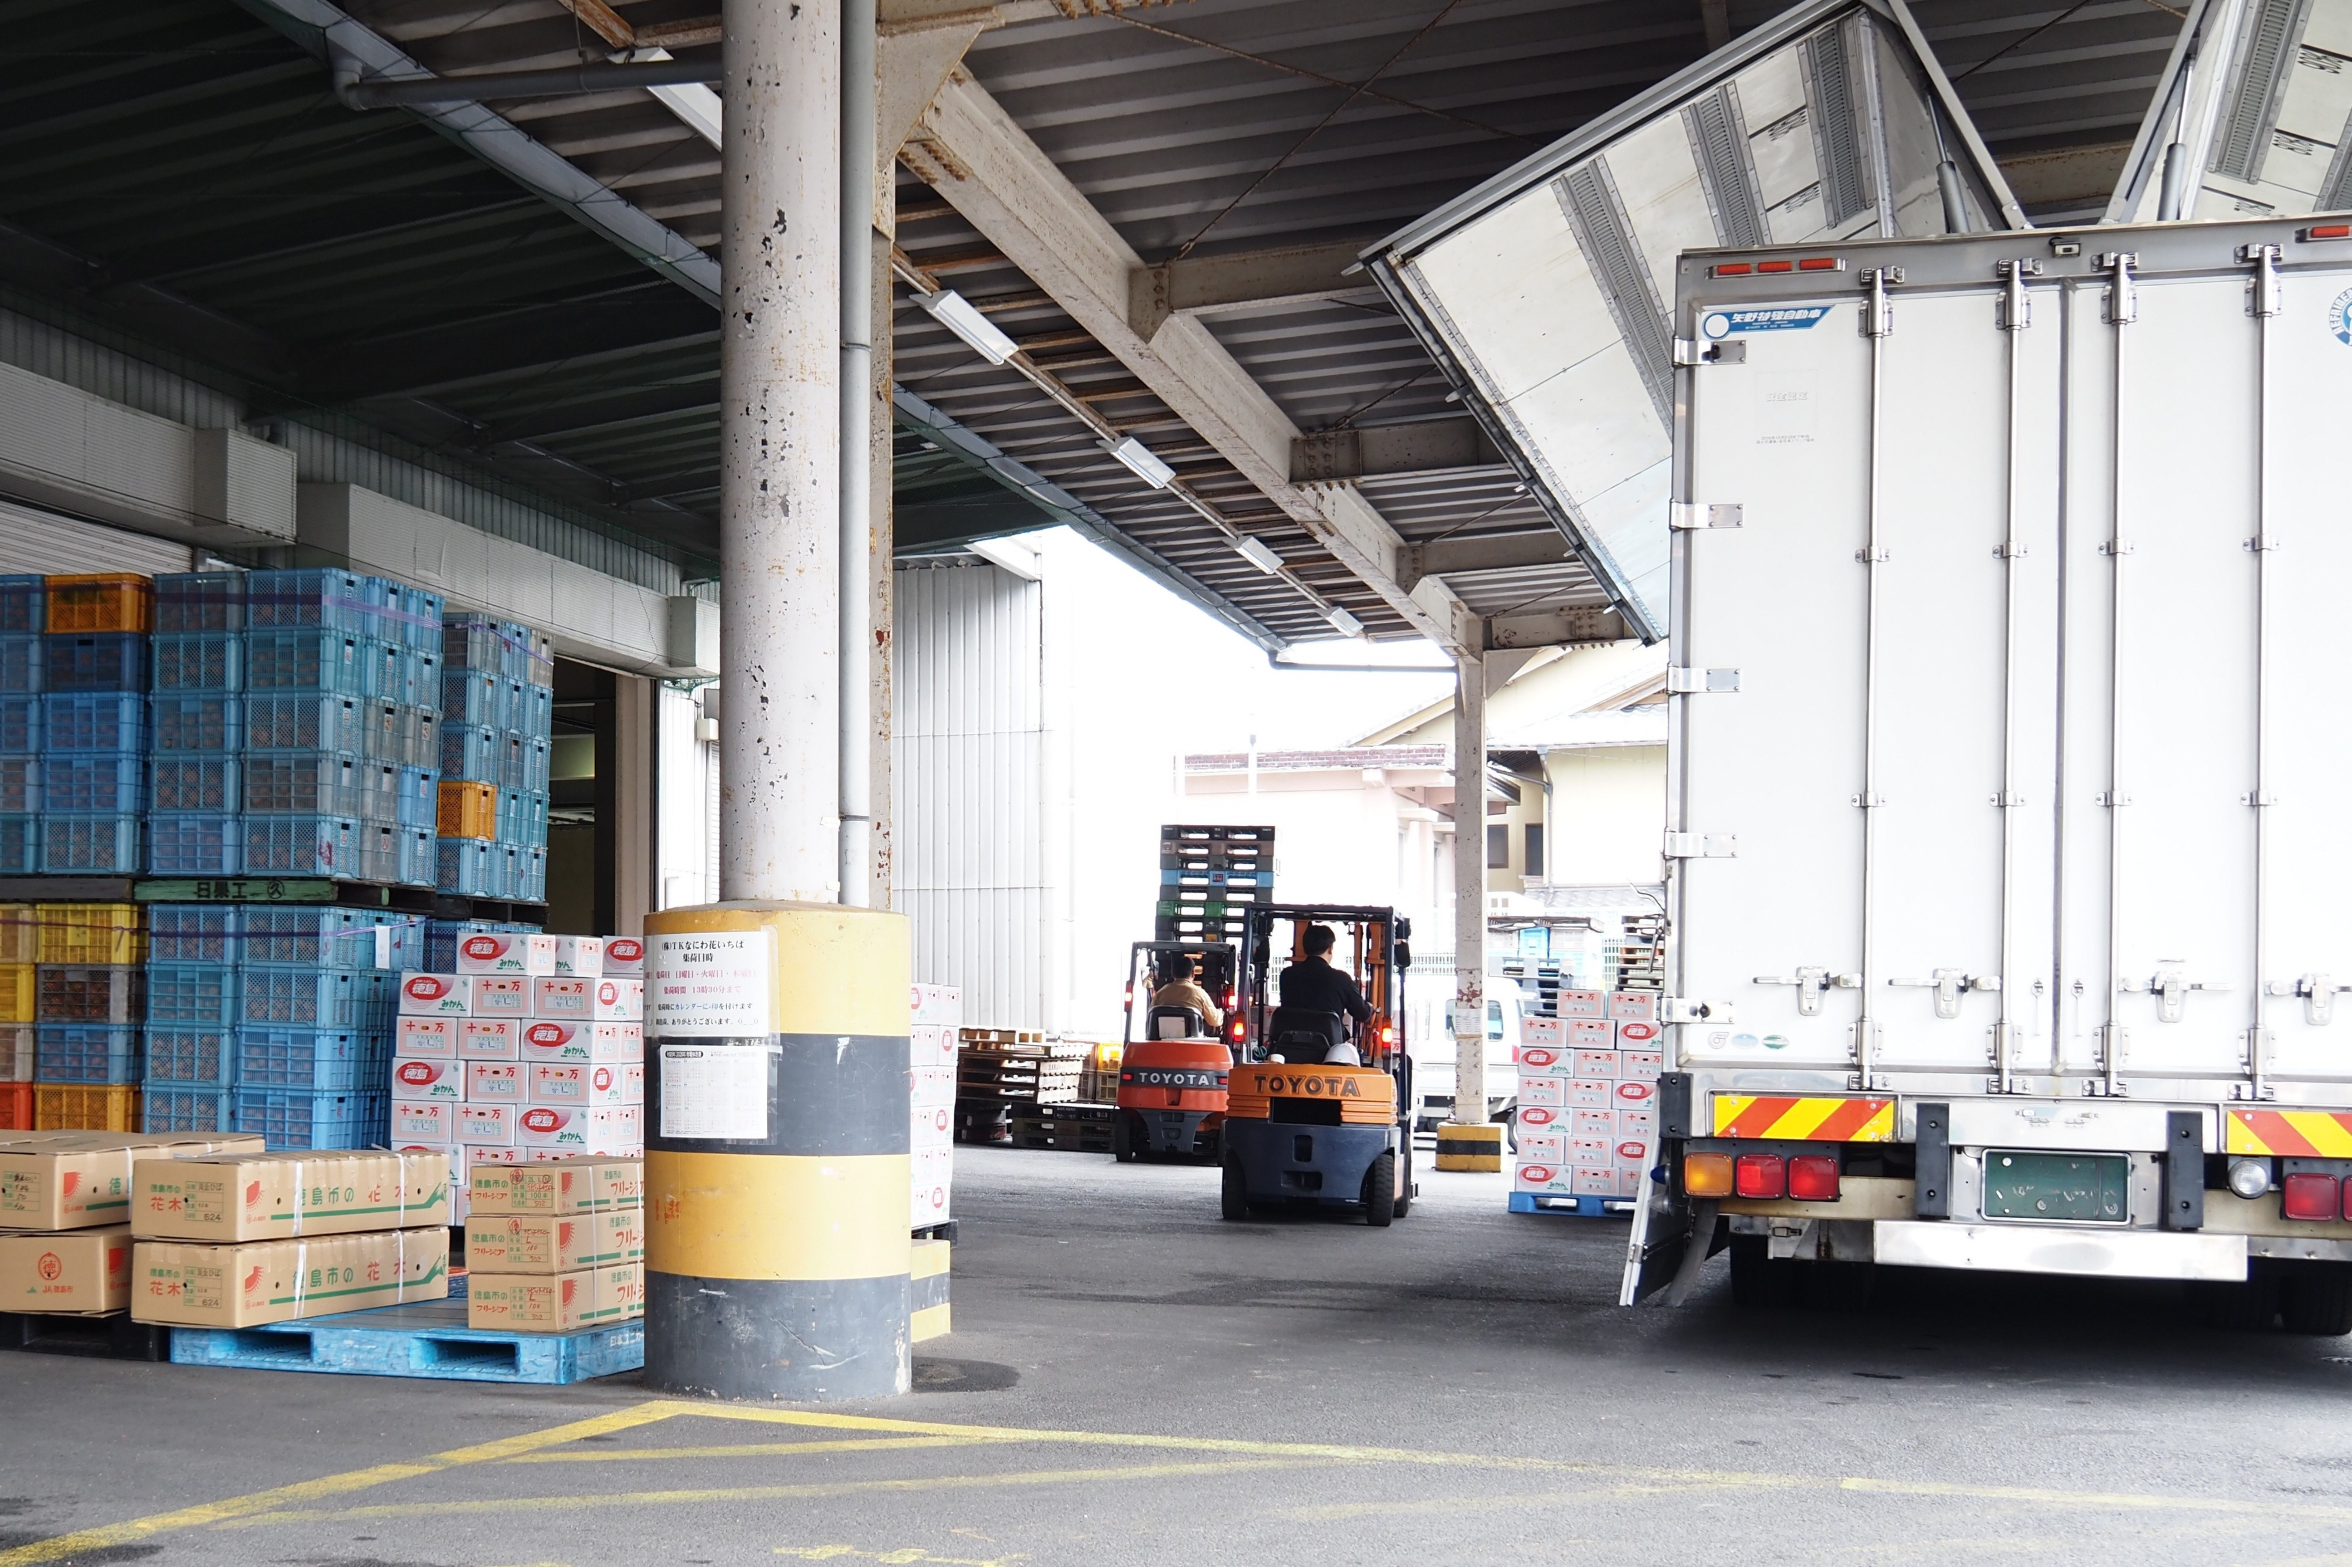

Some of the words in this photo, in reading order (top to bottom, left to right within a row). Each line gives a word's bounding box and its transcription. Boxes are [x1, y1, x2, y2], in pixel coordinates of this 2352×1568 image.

[1731, 309, 1823, 323] 矢野特殊自動車
[683, 953, 714, 962] 集荷日時
[500, 959, 522, 968] みかん
[664, 985, 686, 995] 集荷時間
[441, 1000, 464, 1008] みかん
[564, 1047, 587, 1055] みかん
[1139, 1072, 1209, 1086] TOYOTA
[433, 1084, 455, 1093] みかん
[1254, 1073, 1361, 1097] TOYOTA
[559, 1132, 582, 1141] みかん
[151, 1183, 181, 1194] 徳島市の
[475, 1179, 508, 1189] 徳島市の
[151, 1196, 182, 1212] 花木
[610, 1216, 631, 1228] 徳島市の
[472, 1233, 505, 1243] 徳島市の
[150, 1268, 180, 1279] 徳島市の
[611, 1271, 632, 1283] 徳島市の
[150, 1281, 181, 1297] 花木
[475, 1290, 508, 1300] 徳島市の
[202, 1298, 219, 1306] 624
